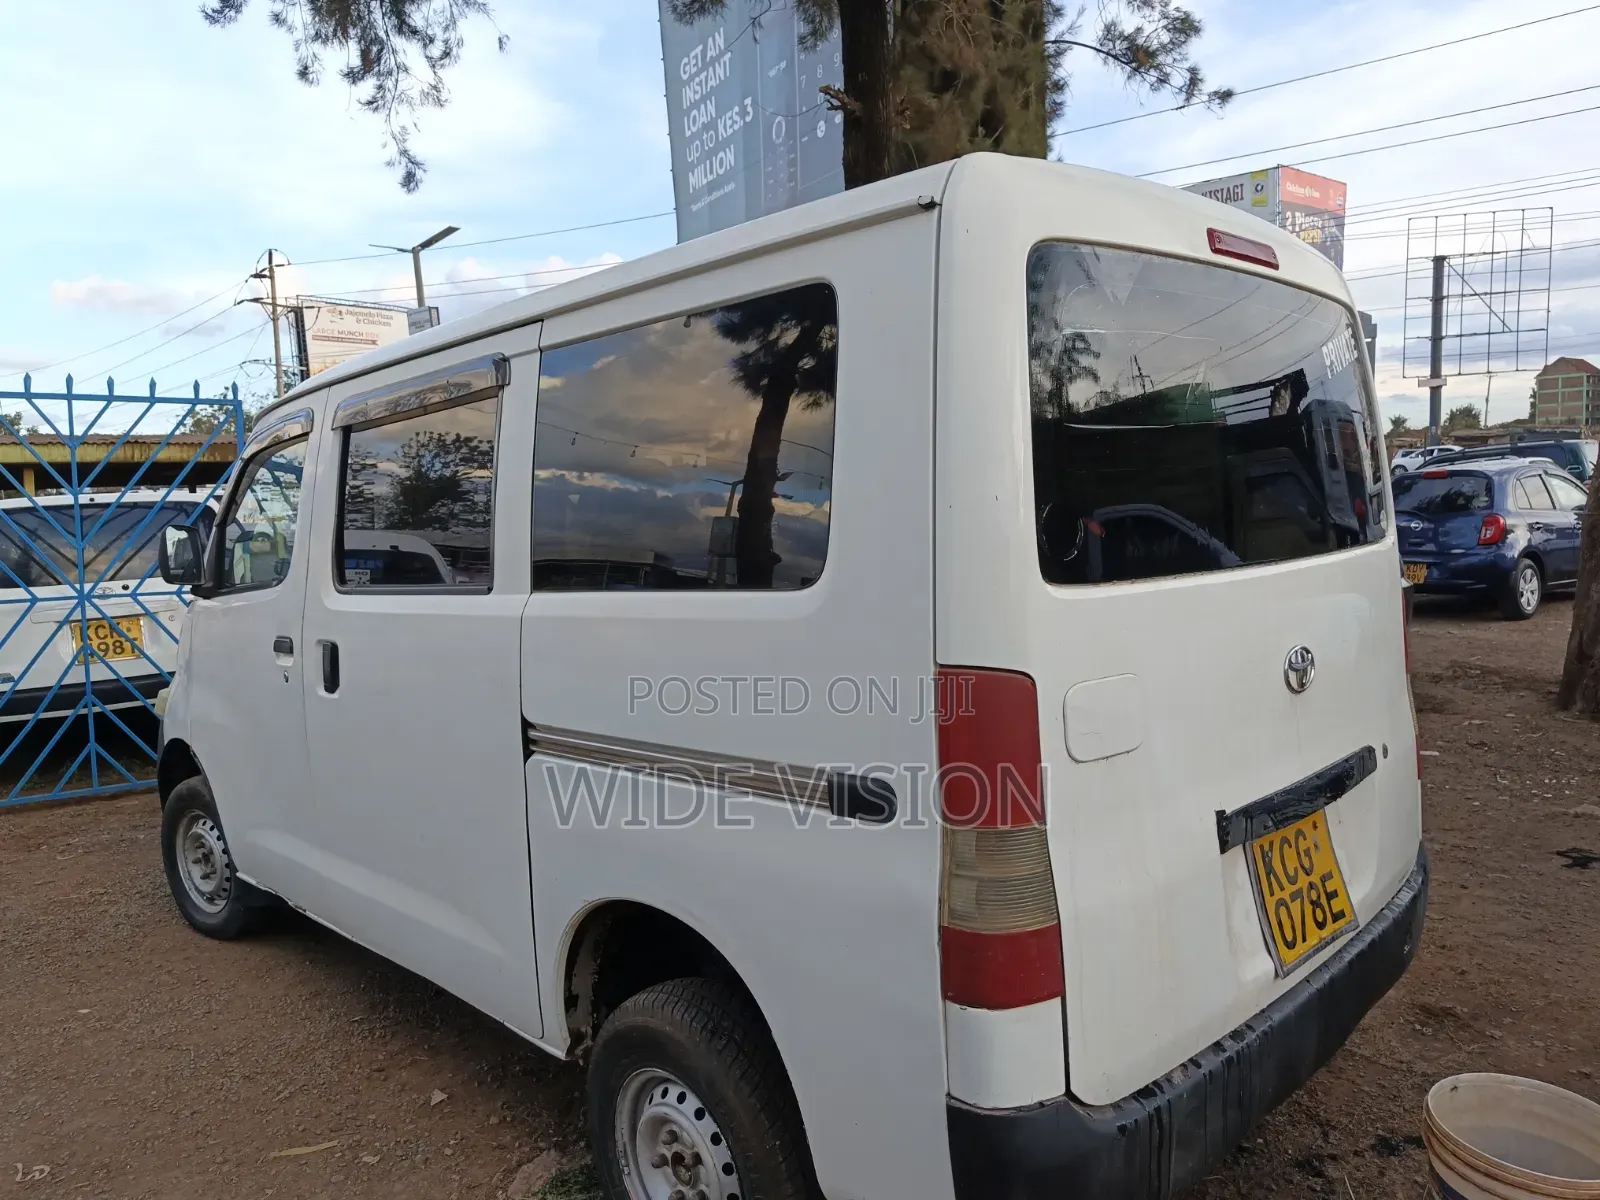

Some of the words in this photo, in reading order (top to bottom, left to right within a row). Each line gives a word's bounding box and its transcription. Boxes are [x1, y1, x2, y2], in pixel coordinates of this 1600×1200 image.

[680, 44, 703, 81] GET
[706, 27, 725, 62] AN
[800, 75, 806, 88] 7
[816, 64, 823, 78] 8
[833, 53, 840, 67] 9
[682, 52, 731, 110] INSTANT
[684, 96, 716, 138] LOAN
[686, 145, 701, 164] up
[703, 130, 716, 150] to
[744, 96, 753, 123] 3
[688, 144, 735, 194] MILLION
[1201, 183, 1244, 205] ISIAGI
[1285, 211, 1293, 231] 2
[337, 329, 363, 338] MUNCH
[356, 317, 362, 325] &
[362, 319, 392, 328] Chicken
[376, 312, 394, 321] Pizza
[1321, 327, 1358, 379] PRIVATE
[1258, 827, 1315, 898] KCG
[1274, 869, 1347, 951] 078E
